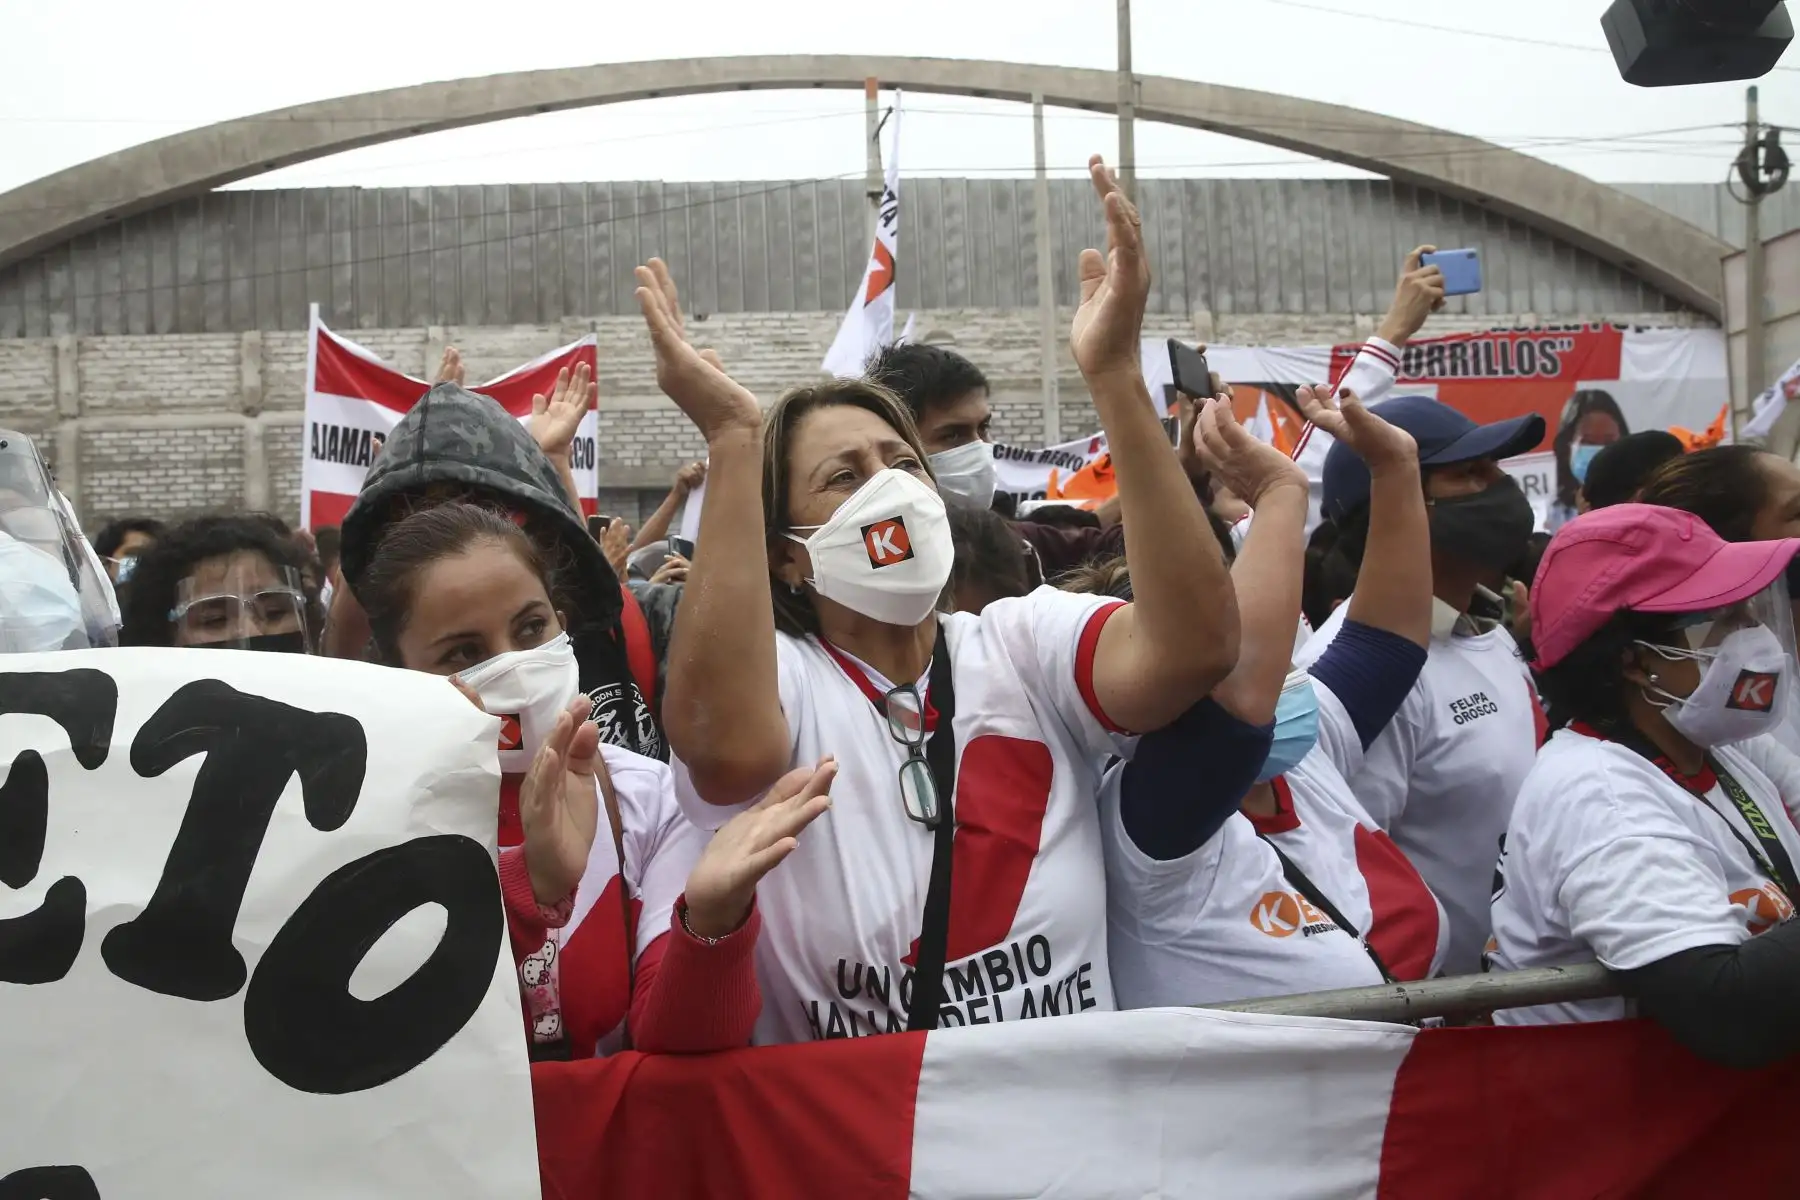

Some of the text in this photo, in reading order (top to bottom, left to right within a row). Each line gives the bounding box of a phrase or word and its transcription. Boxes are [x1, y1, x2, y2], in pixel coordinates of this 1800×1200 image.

[569, 436, 595, 471] CIO
[1037, 449, 1091, 472] REGIO
[1517, 473, 1549, 496] RI
[871, 526, 904, 560] K
[590, 691, 613, 713] RDON
[1449, 692, 1489, 714] FELIPA
[1738, 679, 1771, 706] K
[1453, 702, 1498, 725] OROSCO
[837, 934, 1052, 1014] UN CMBIO
